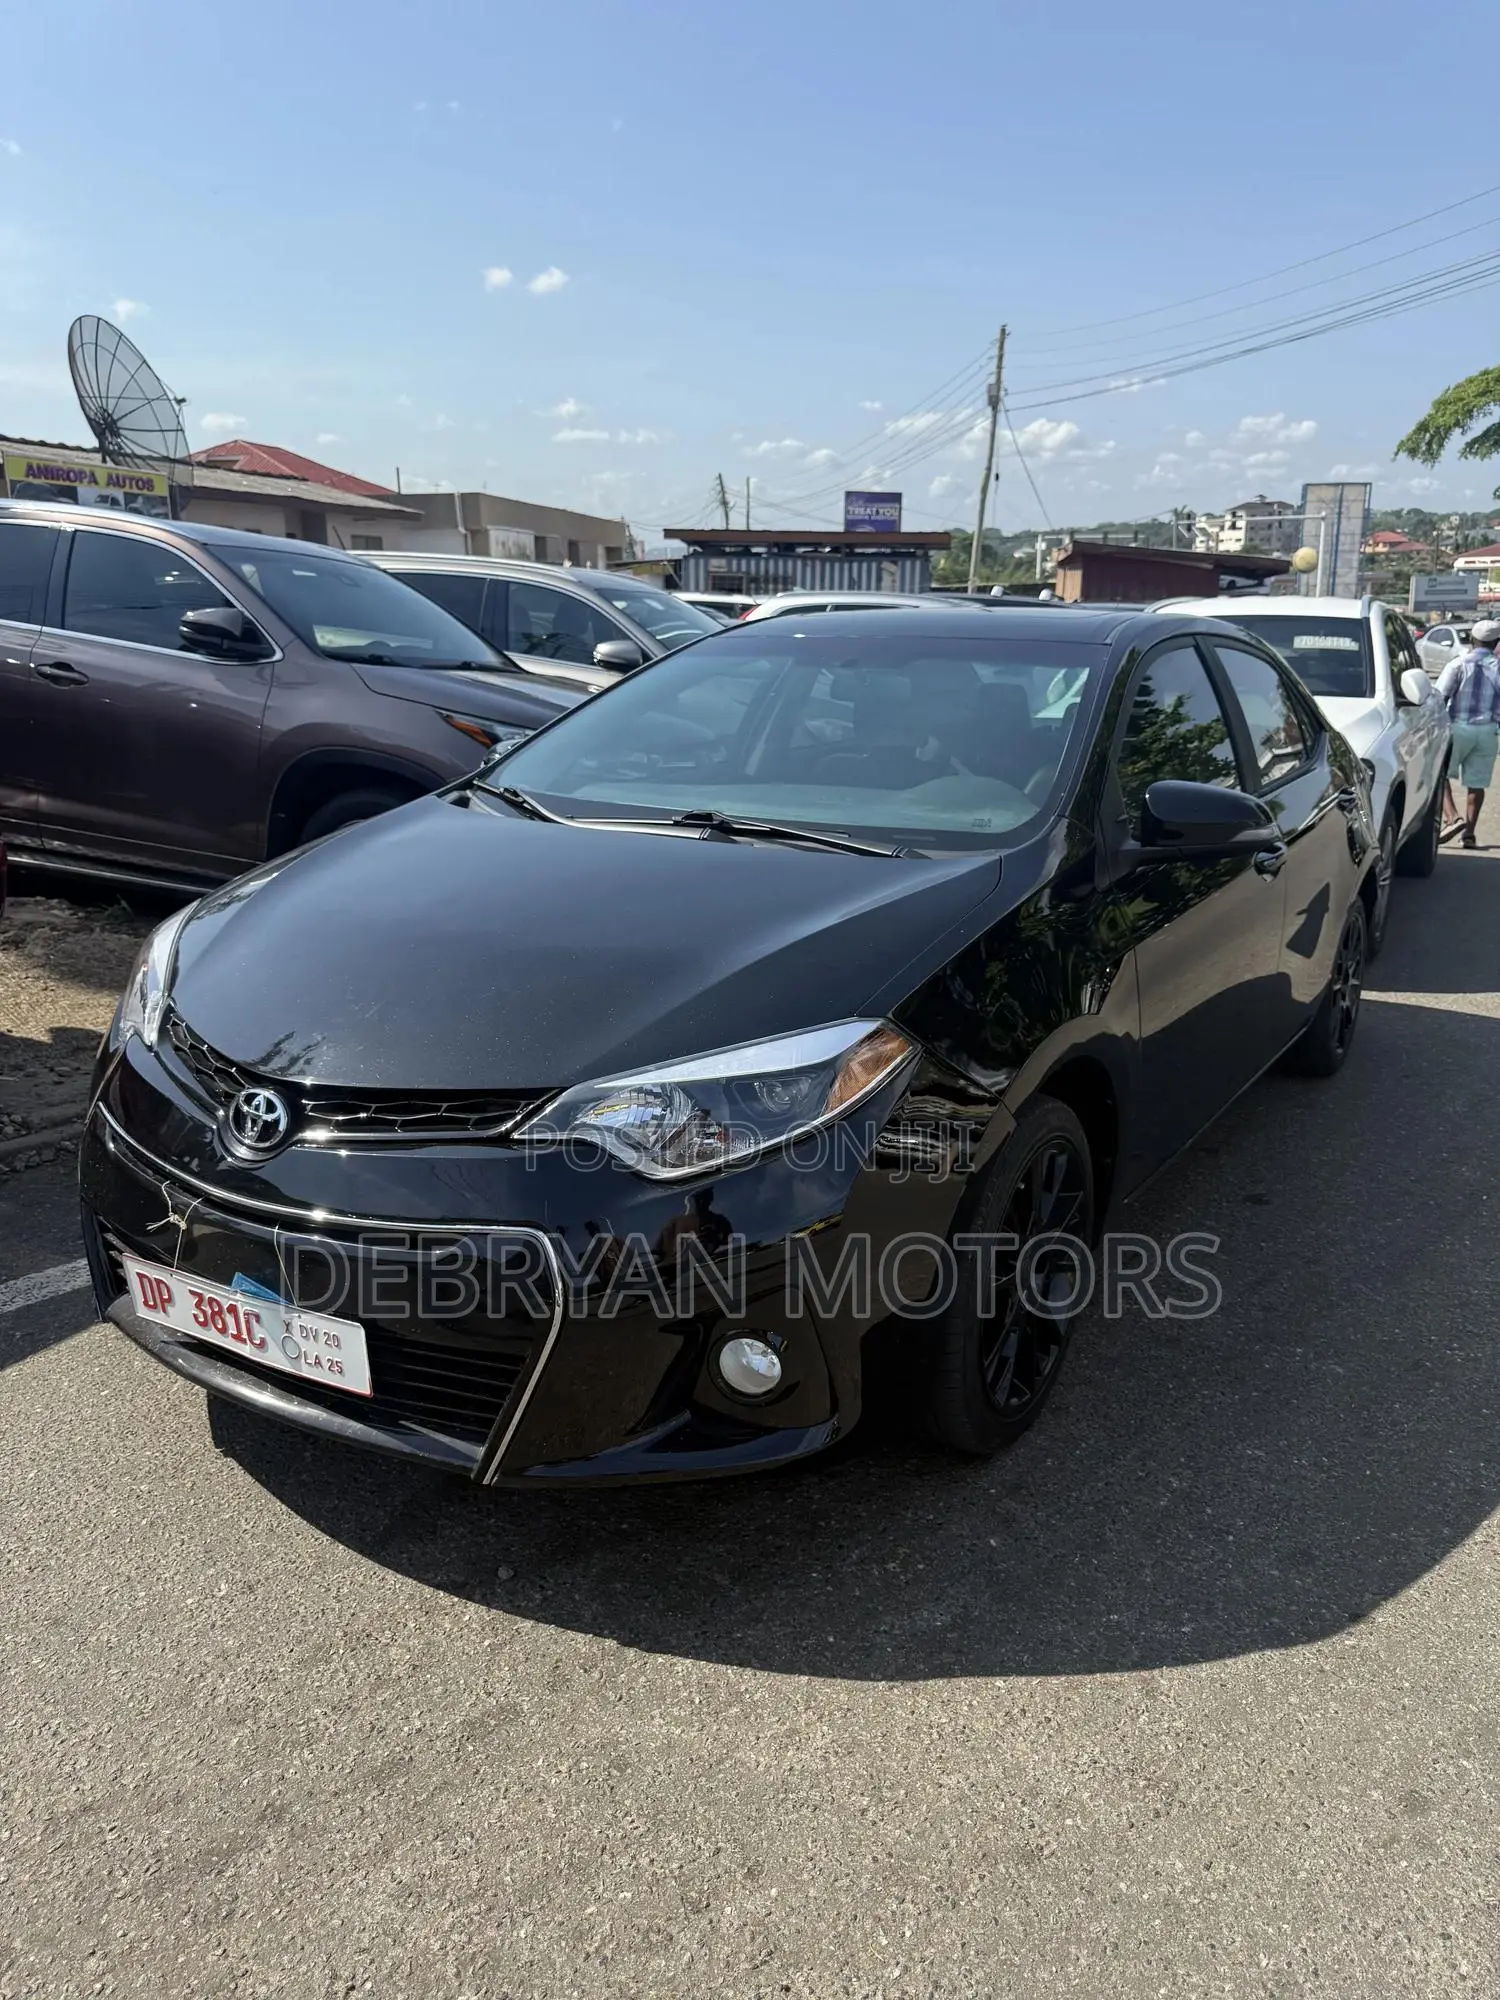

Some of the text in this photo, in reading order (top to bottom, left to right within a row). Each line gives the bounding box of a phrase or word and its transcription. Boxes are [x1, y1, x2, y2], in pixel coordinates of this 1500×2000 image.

[106, 473, 155, 492] AUTOS
[135, 1271, 267, 1350] DP 381C
[298, 1322, 320, 1343] DV
[323, 1330, 342, 1349] 20
[303, 1349, 345, 1376] LA 25
